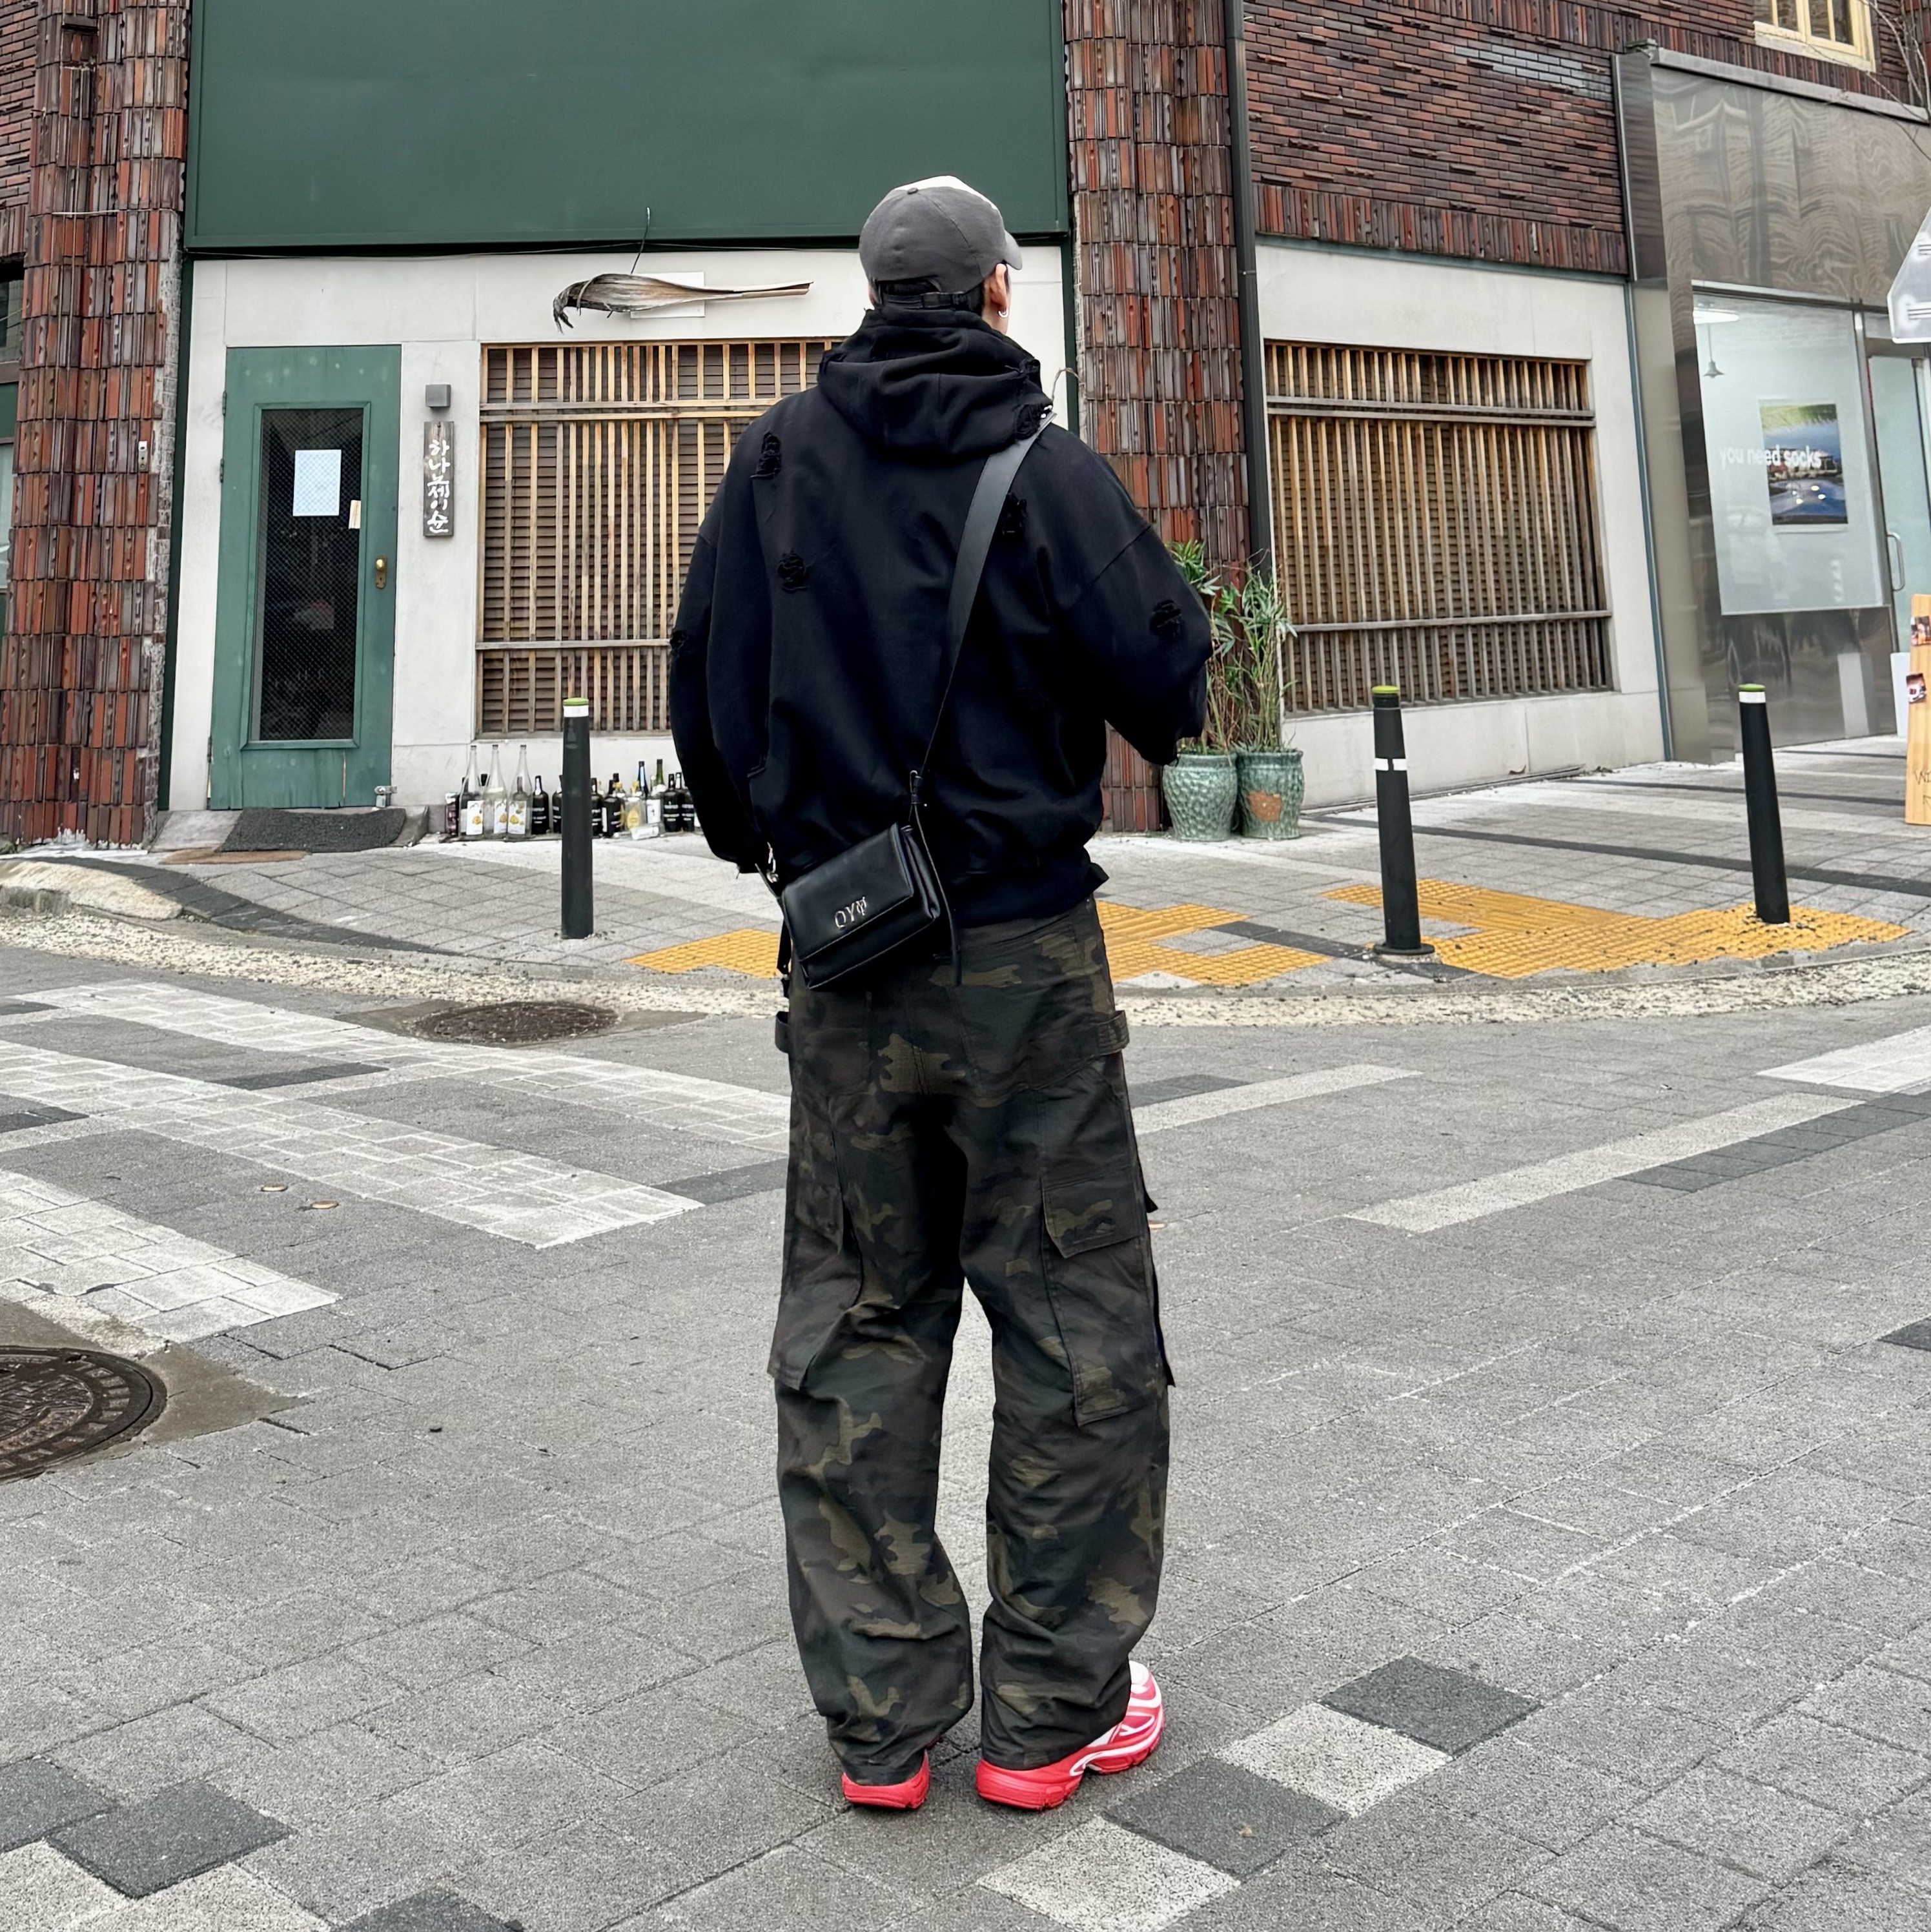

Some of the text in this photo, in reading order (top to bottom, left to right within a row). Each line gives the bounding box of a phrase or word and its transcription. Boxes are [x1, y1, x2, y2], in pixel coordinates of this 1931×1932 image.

[1720, 445, 1822, 471] you need socks
